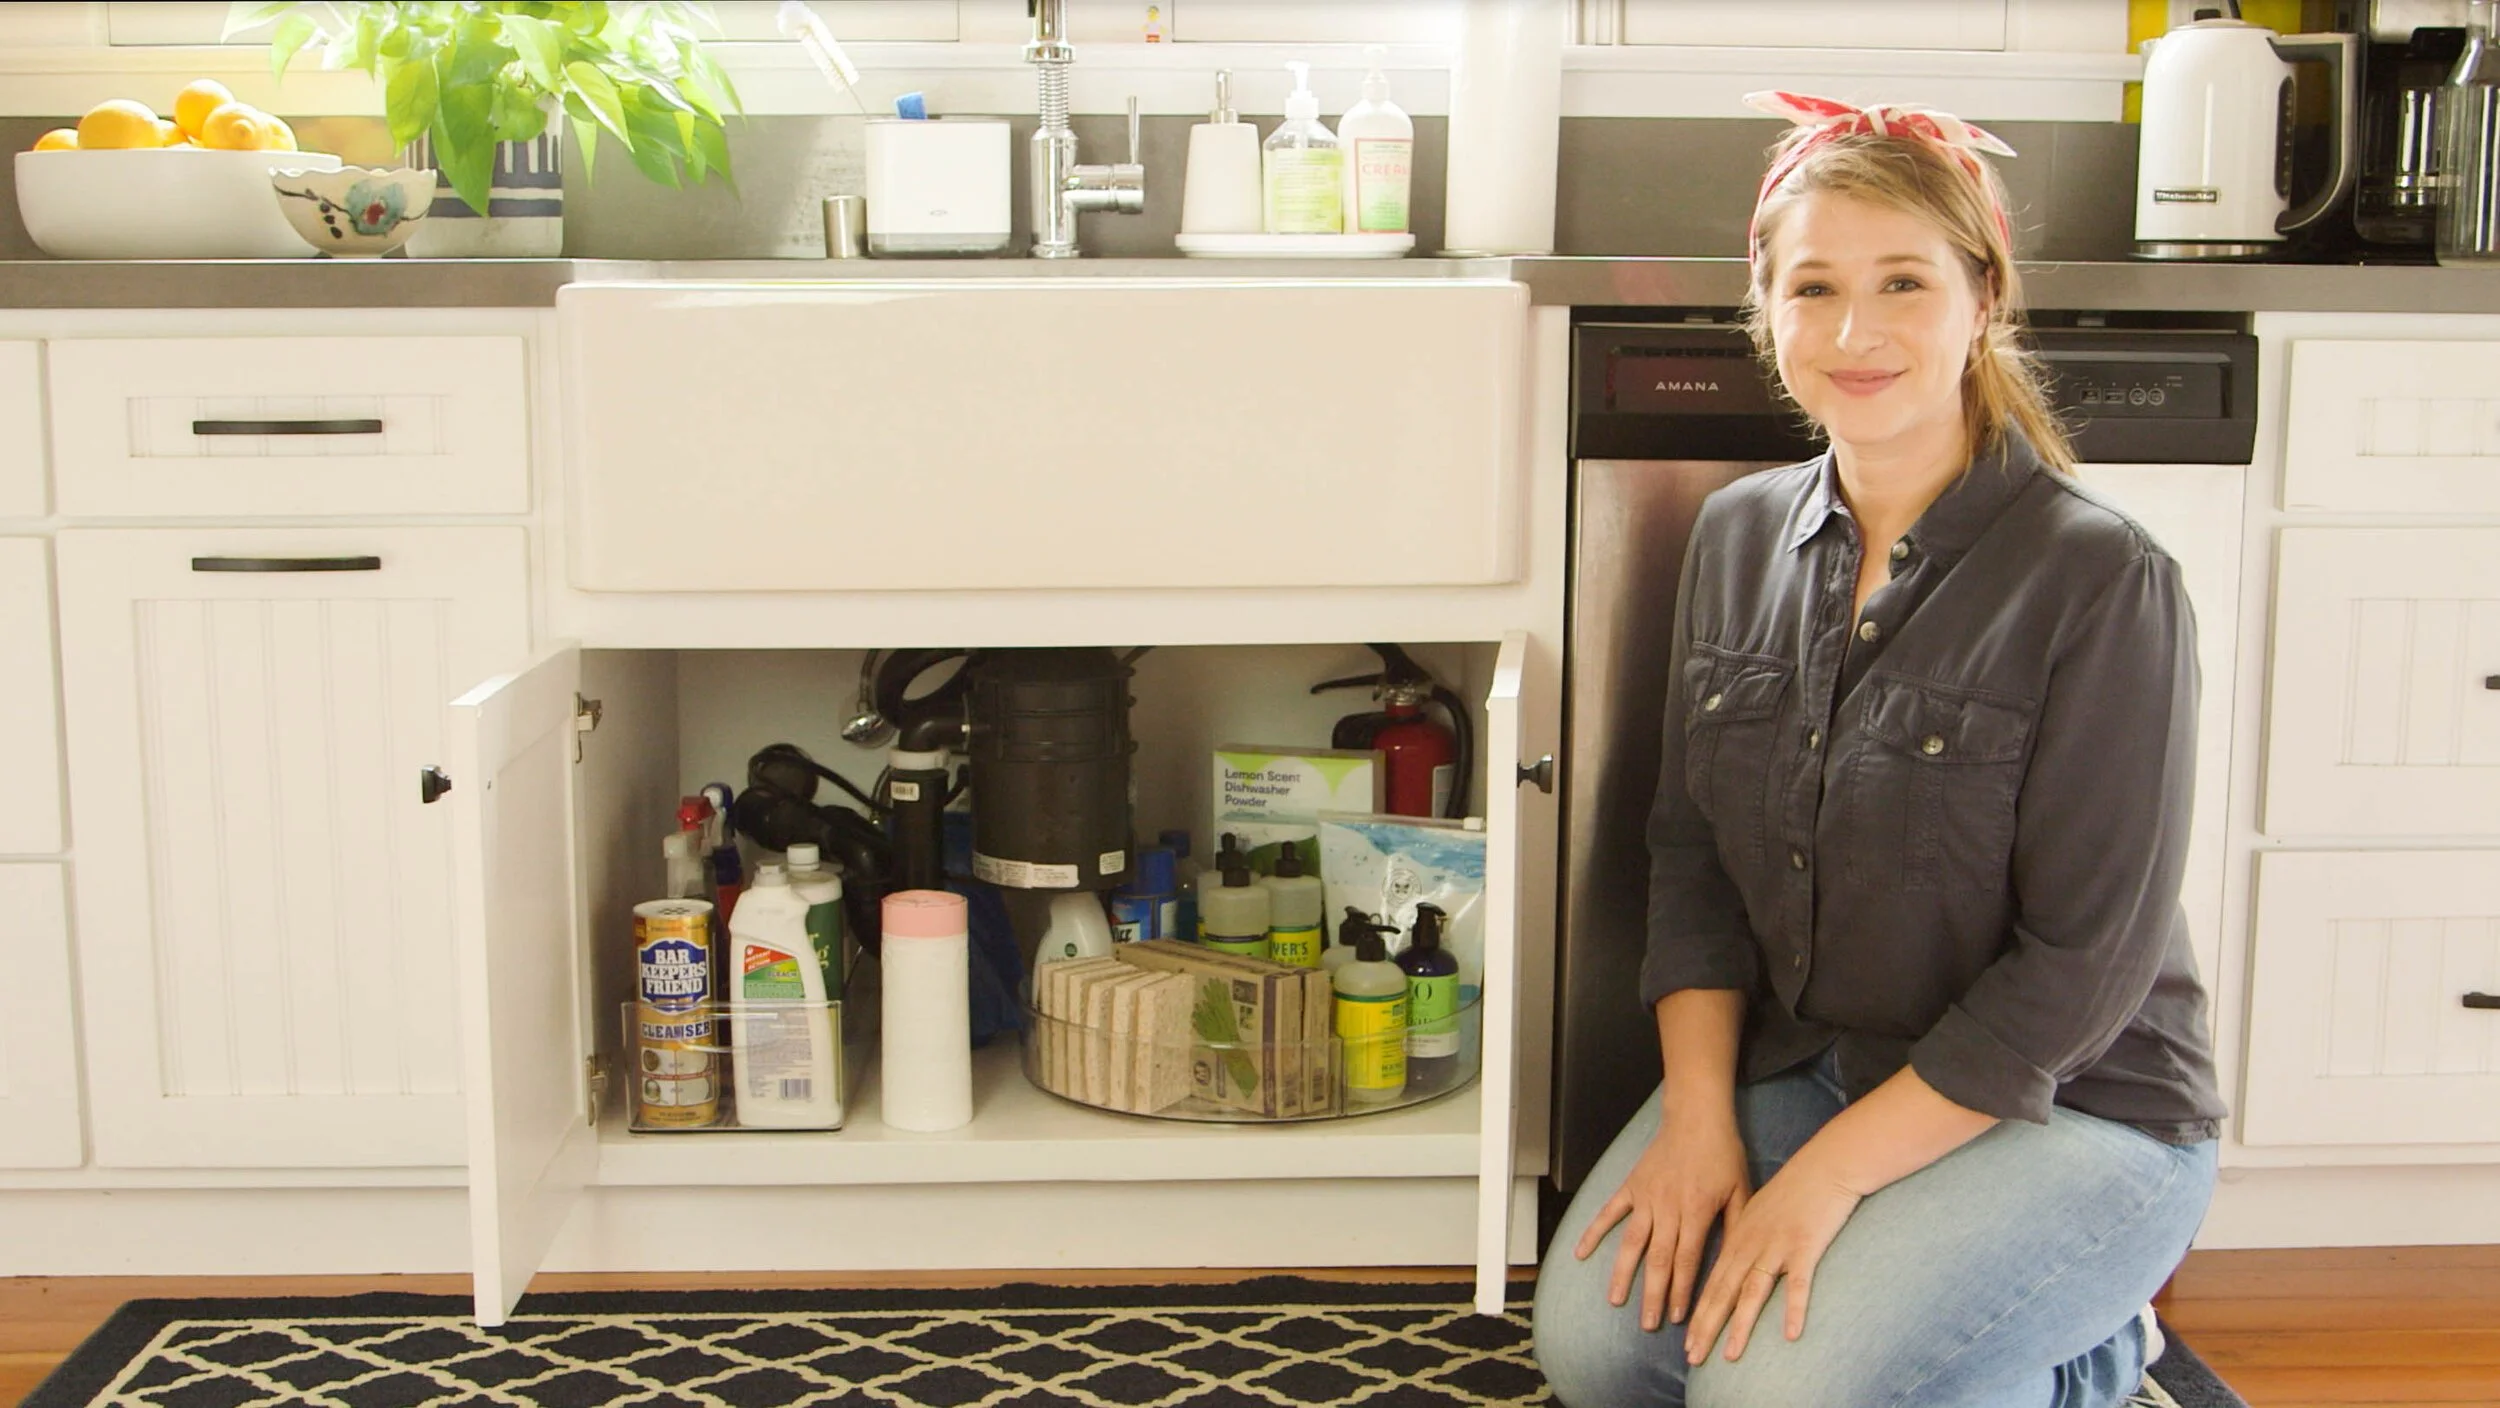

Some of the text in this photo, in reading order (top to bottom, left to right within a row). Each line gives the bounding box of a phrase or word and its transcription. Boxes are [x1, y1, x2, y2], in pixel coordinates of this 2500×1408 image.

[1654, 381, 1719, 391] AMANA
[1225, 768, 1301, 783] Lemon Scent
[1225, 780, 1291, 796] Dishwasher
[1225, 794, 1267, 807] Powder
[655, 949, 690, 964] BAR
[1272, 941, 1308, 957] YER'S
[642, 961, 707, 979] KEEPERS
[646, 977, 703, 995] FRIEND
[642, 1021, 711, 1039] CLEANSER
